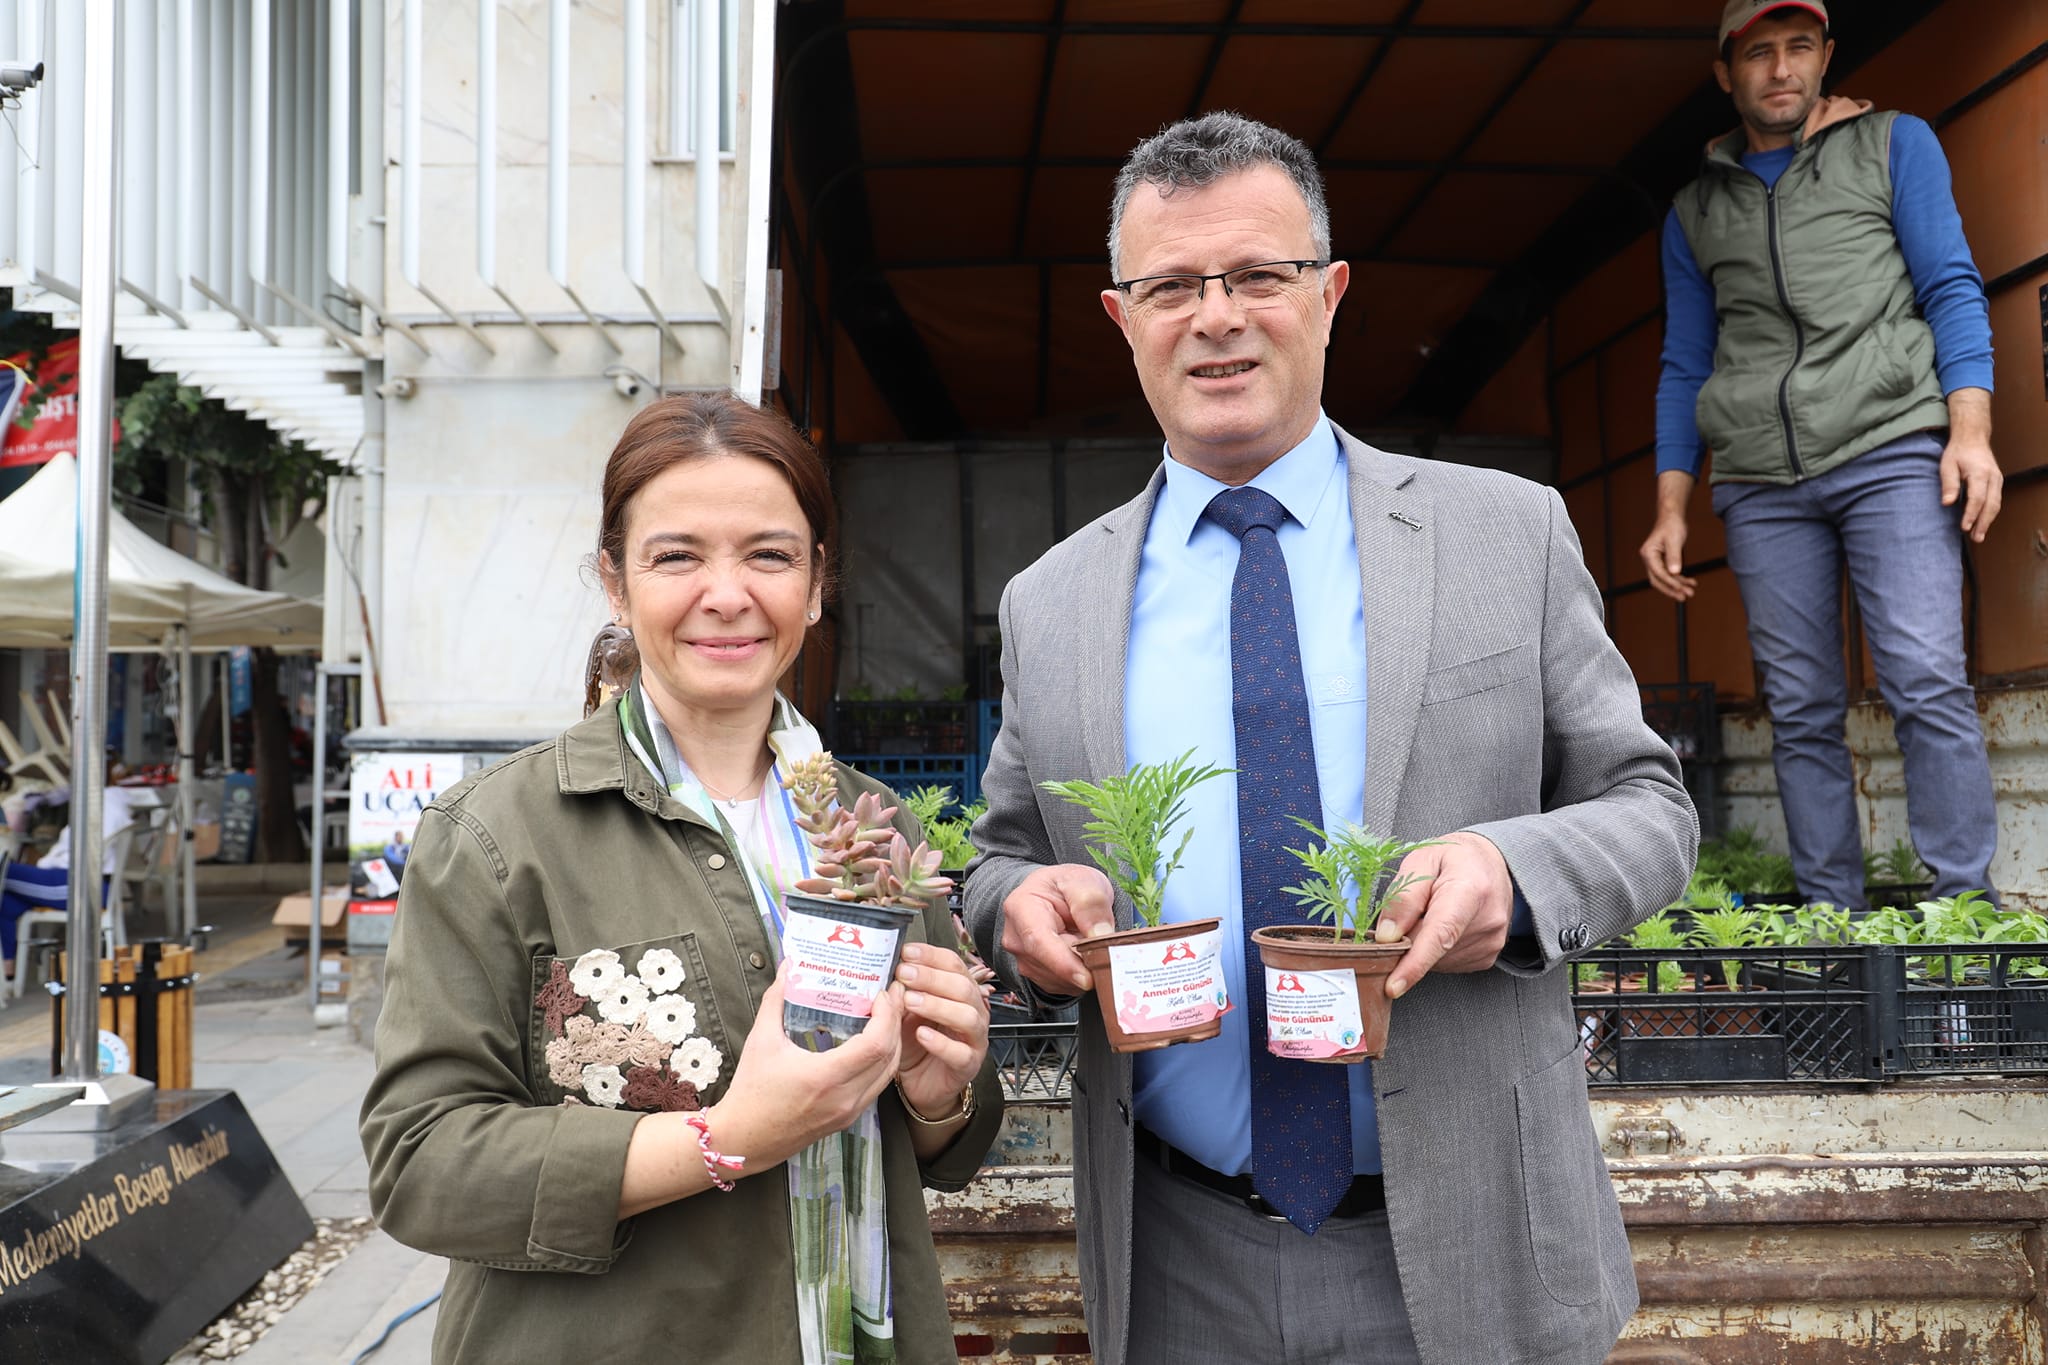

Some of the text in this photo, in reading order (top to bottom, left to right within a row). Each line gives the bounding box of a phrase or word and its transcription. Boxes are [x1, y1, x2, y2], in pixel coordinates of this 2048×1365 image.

[381, 763, 434, 790] ALİ
[798, 960, 881, 982] Anneler Gününüz
[1142, 987, 1181, 998] Anneler
[1291, 1014, 1334, 1024] Gününüz
